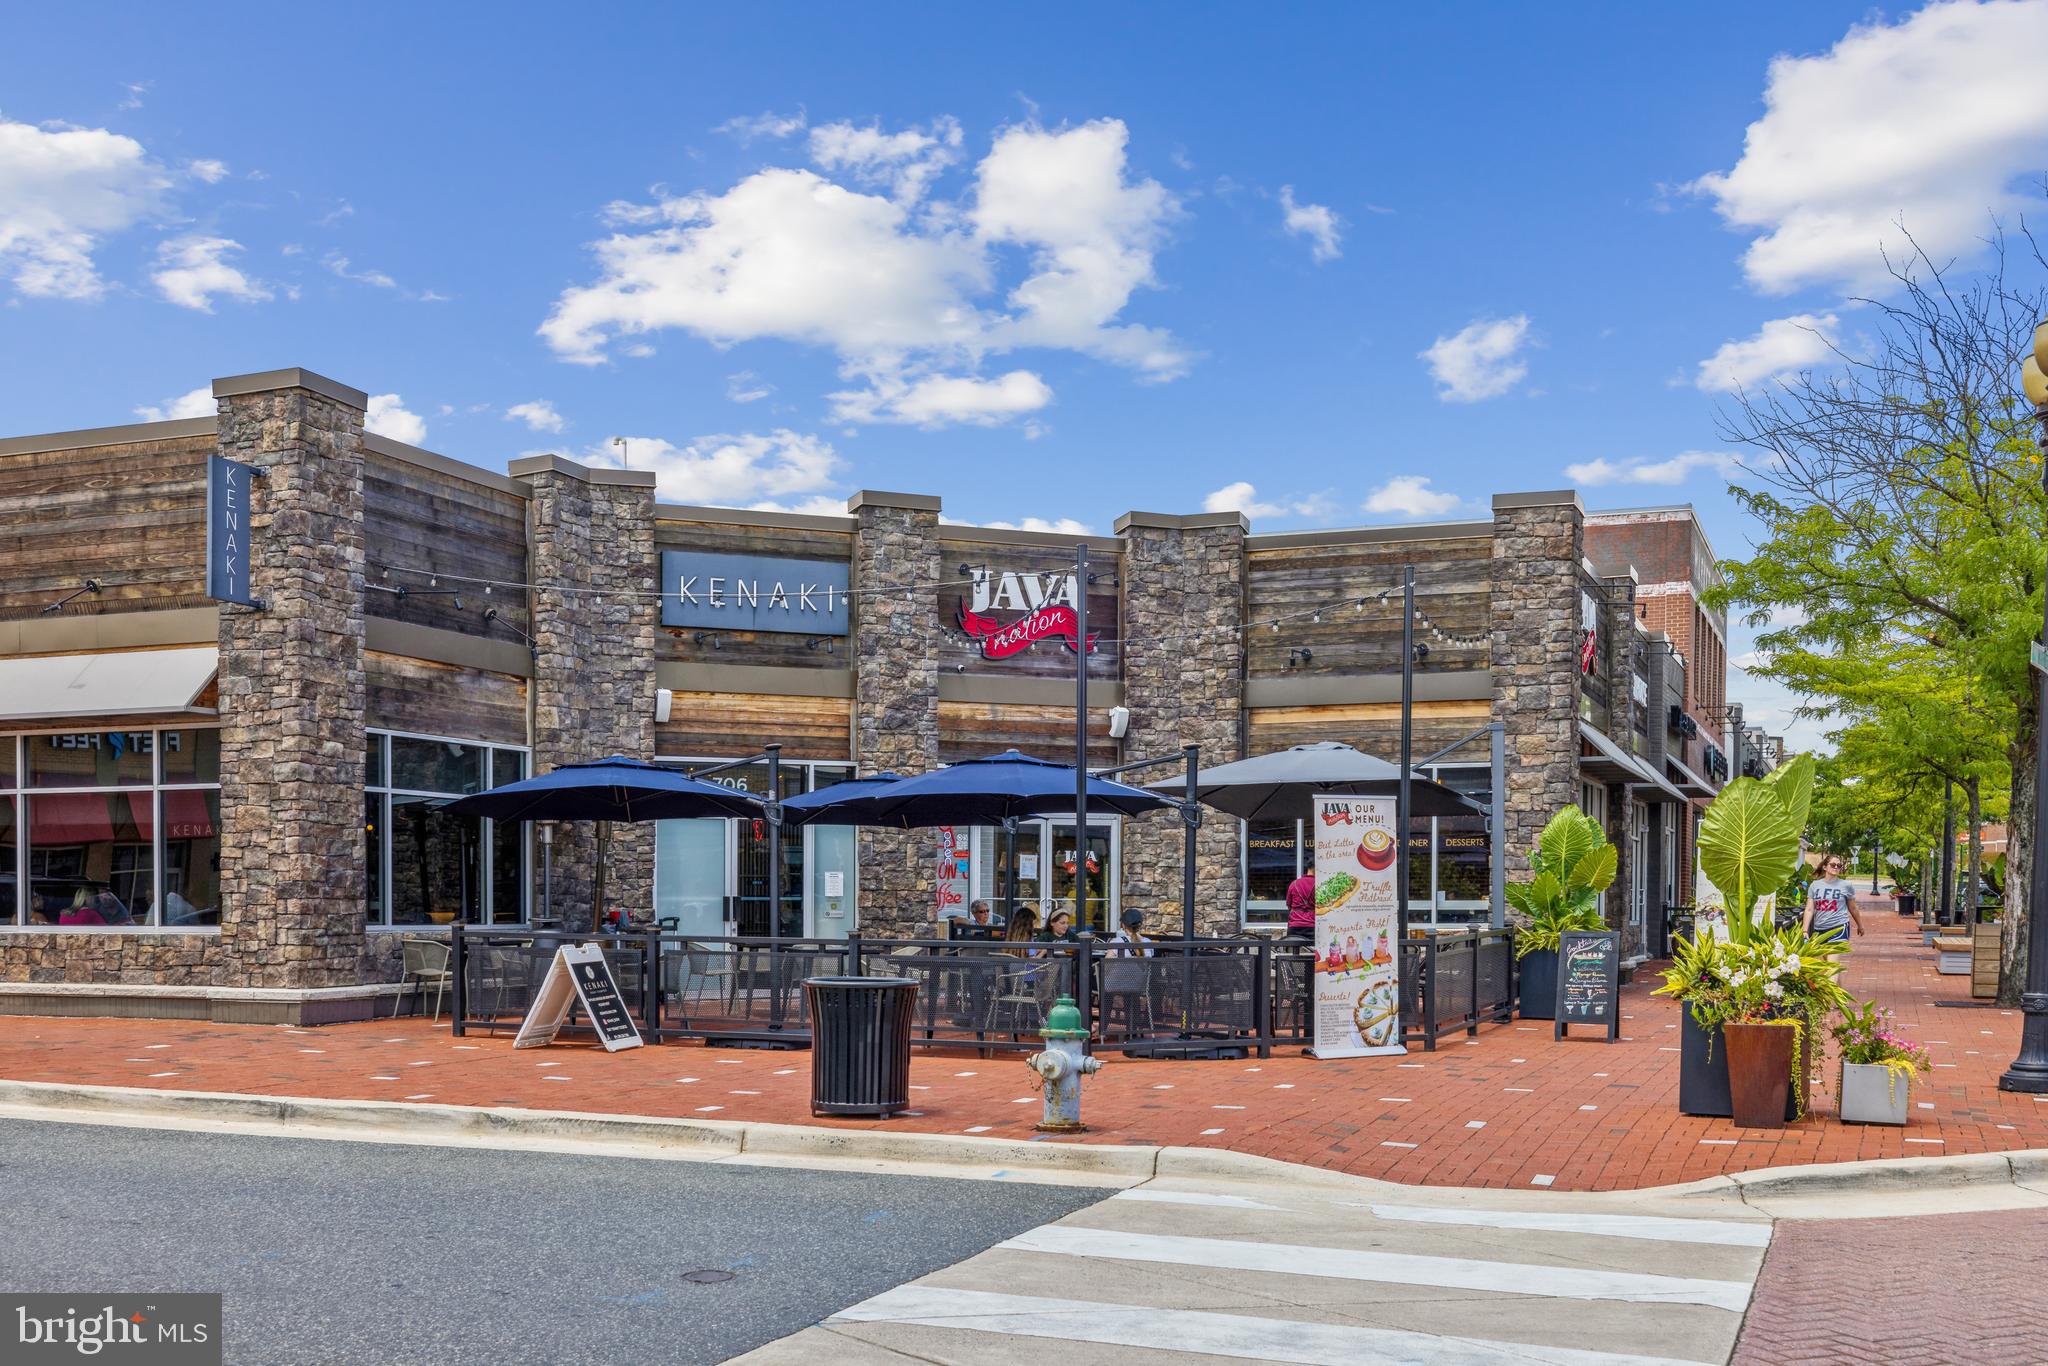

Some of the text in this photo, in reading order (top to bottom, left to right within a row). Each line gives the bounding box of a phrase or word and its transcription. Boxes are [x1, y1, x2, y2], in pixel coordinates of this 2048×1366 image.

[226, 465, 237, 596] KENAKI
[680, 575, 834, 613] KENAKI
[969, 569, 1078, 613] JAVA
[994, 610, 1066, 650] nation
[1322, 803, 1350, 814] JAVA
[1355, 805, 1375, 813] OUR
[1355, 815, 1384, 823] MENU!
[1249, 840, 1295, 848] BREAKFAST
[1445, 838, 1485, 847] DESSERTS
[583, 980, 608, 991] KENAKI
